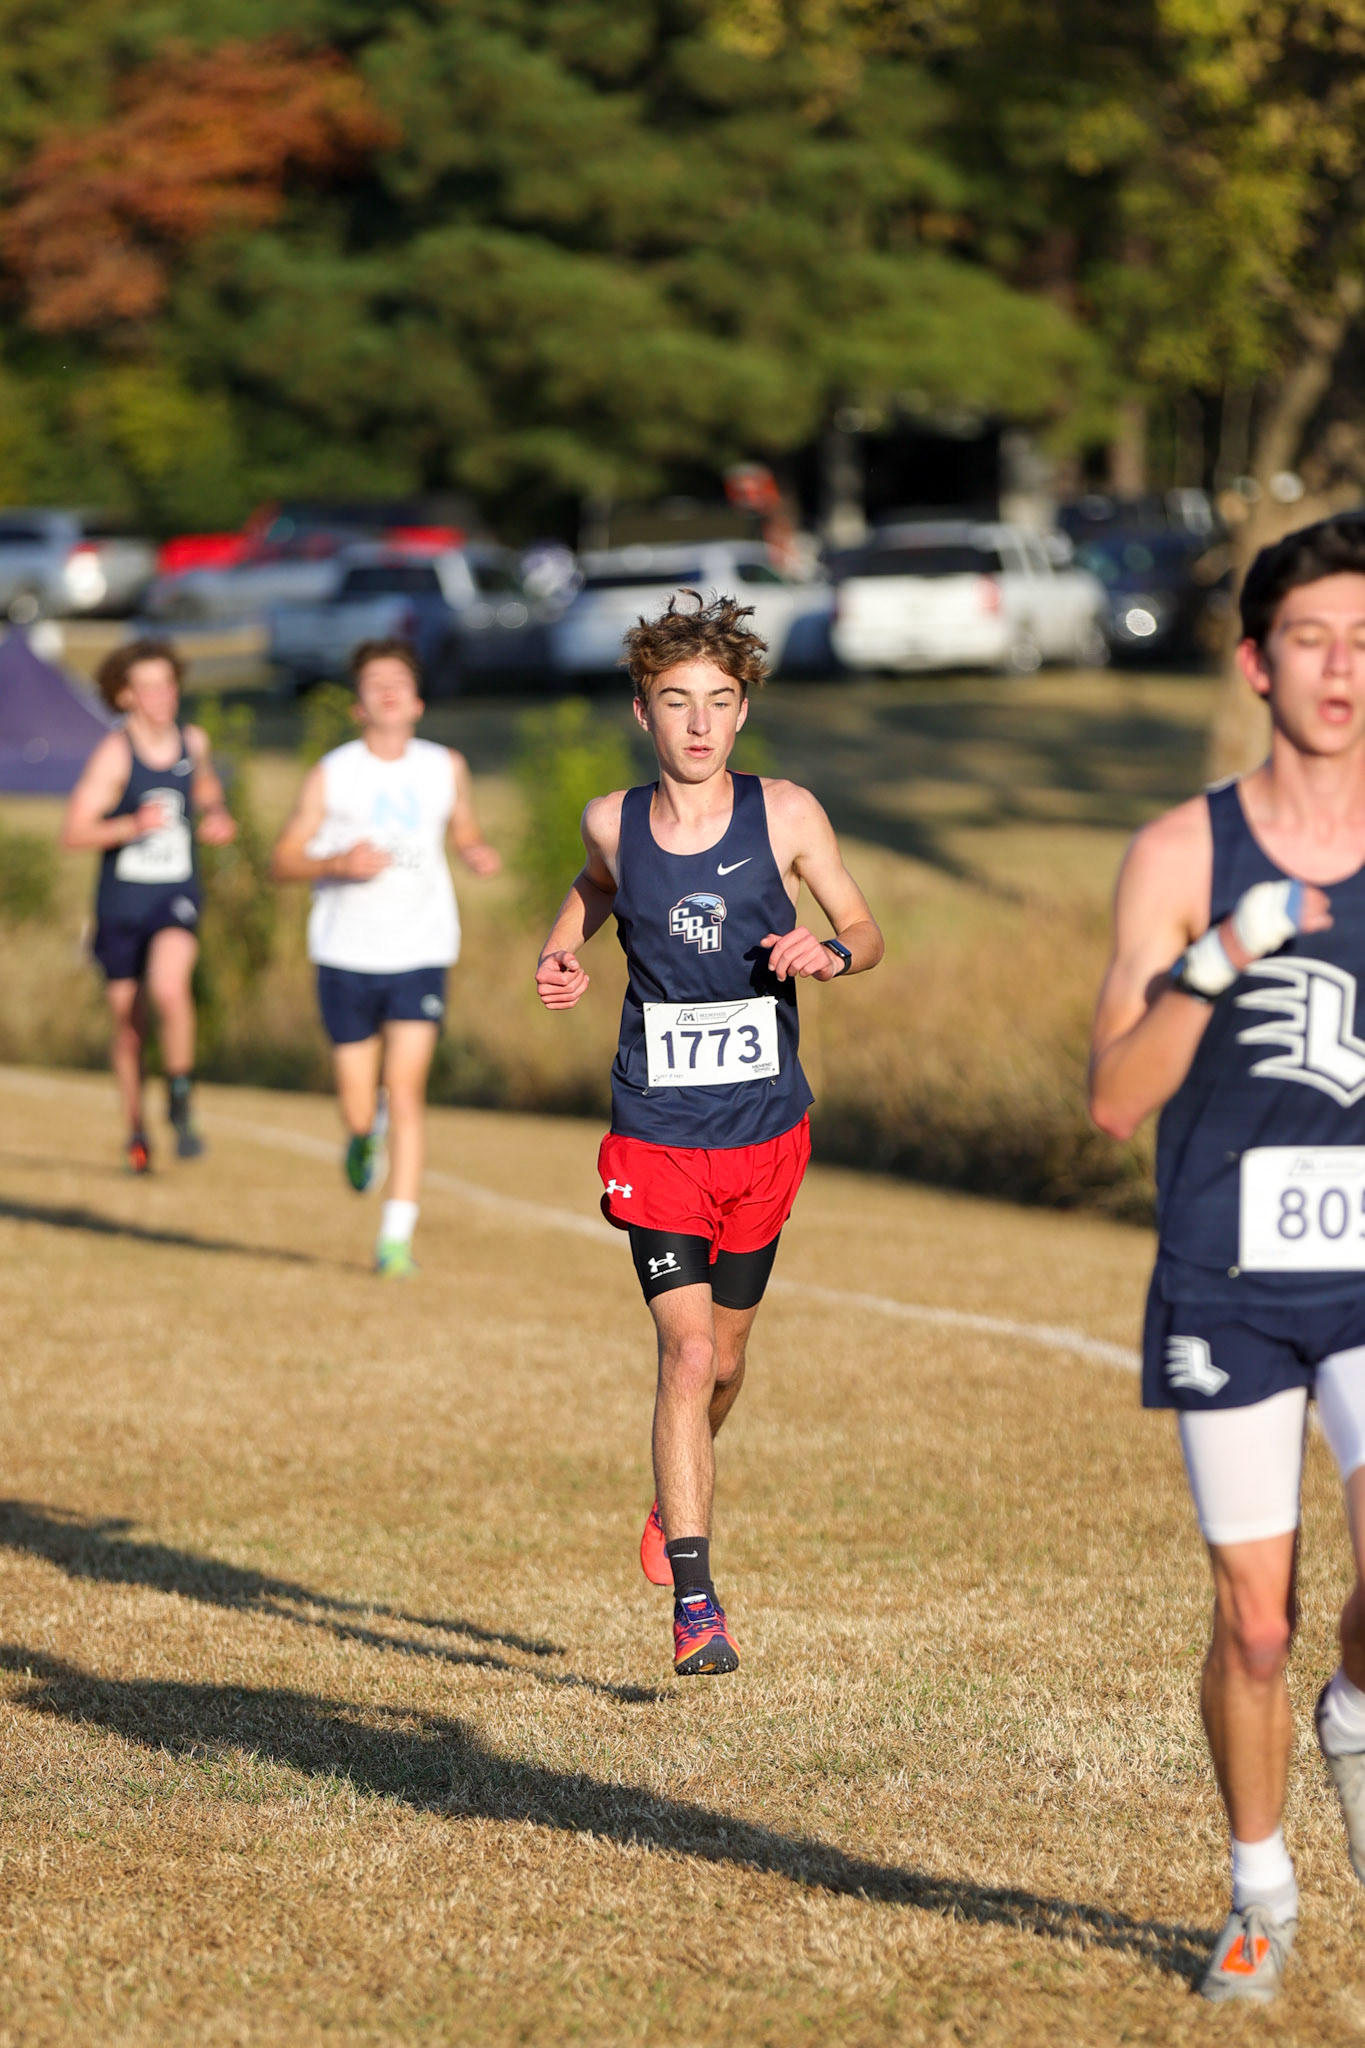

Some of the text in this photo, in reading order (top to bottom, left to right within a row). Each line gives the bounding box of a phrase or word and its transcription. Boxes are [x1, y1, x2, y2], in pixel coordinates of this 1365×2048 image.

[672, 907, 720, 951] SBA
[660, 1024, 762, 1069] 1773
[1277, 1187, 1365, 1240] 80
